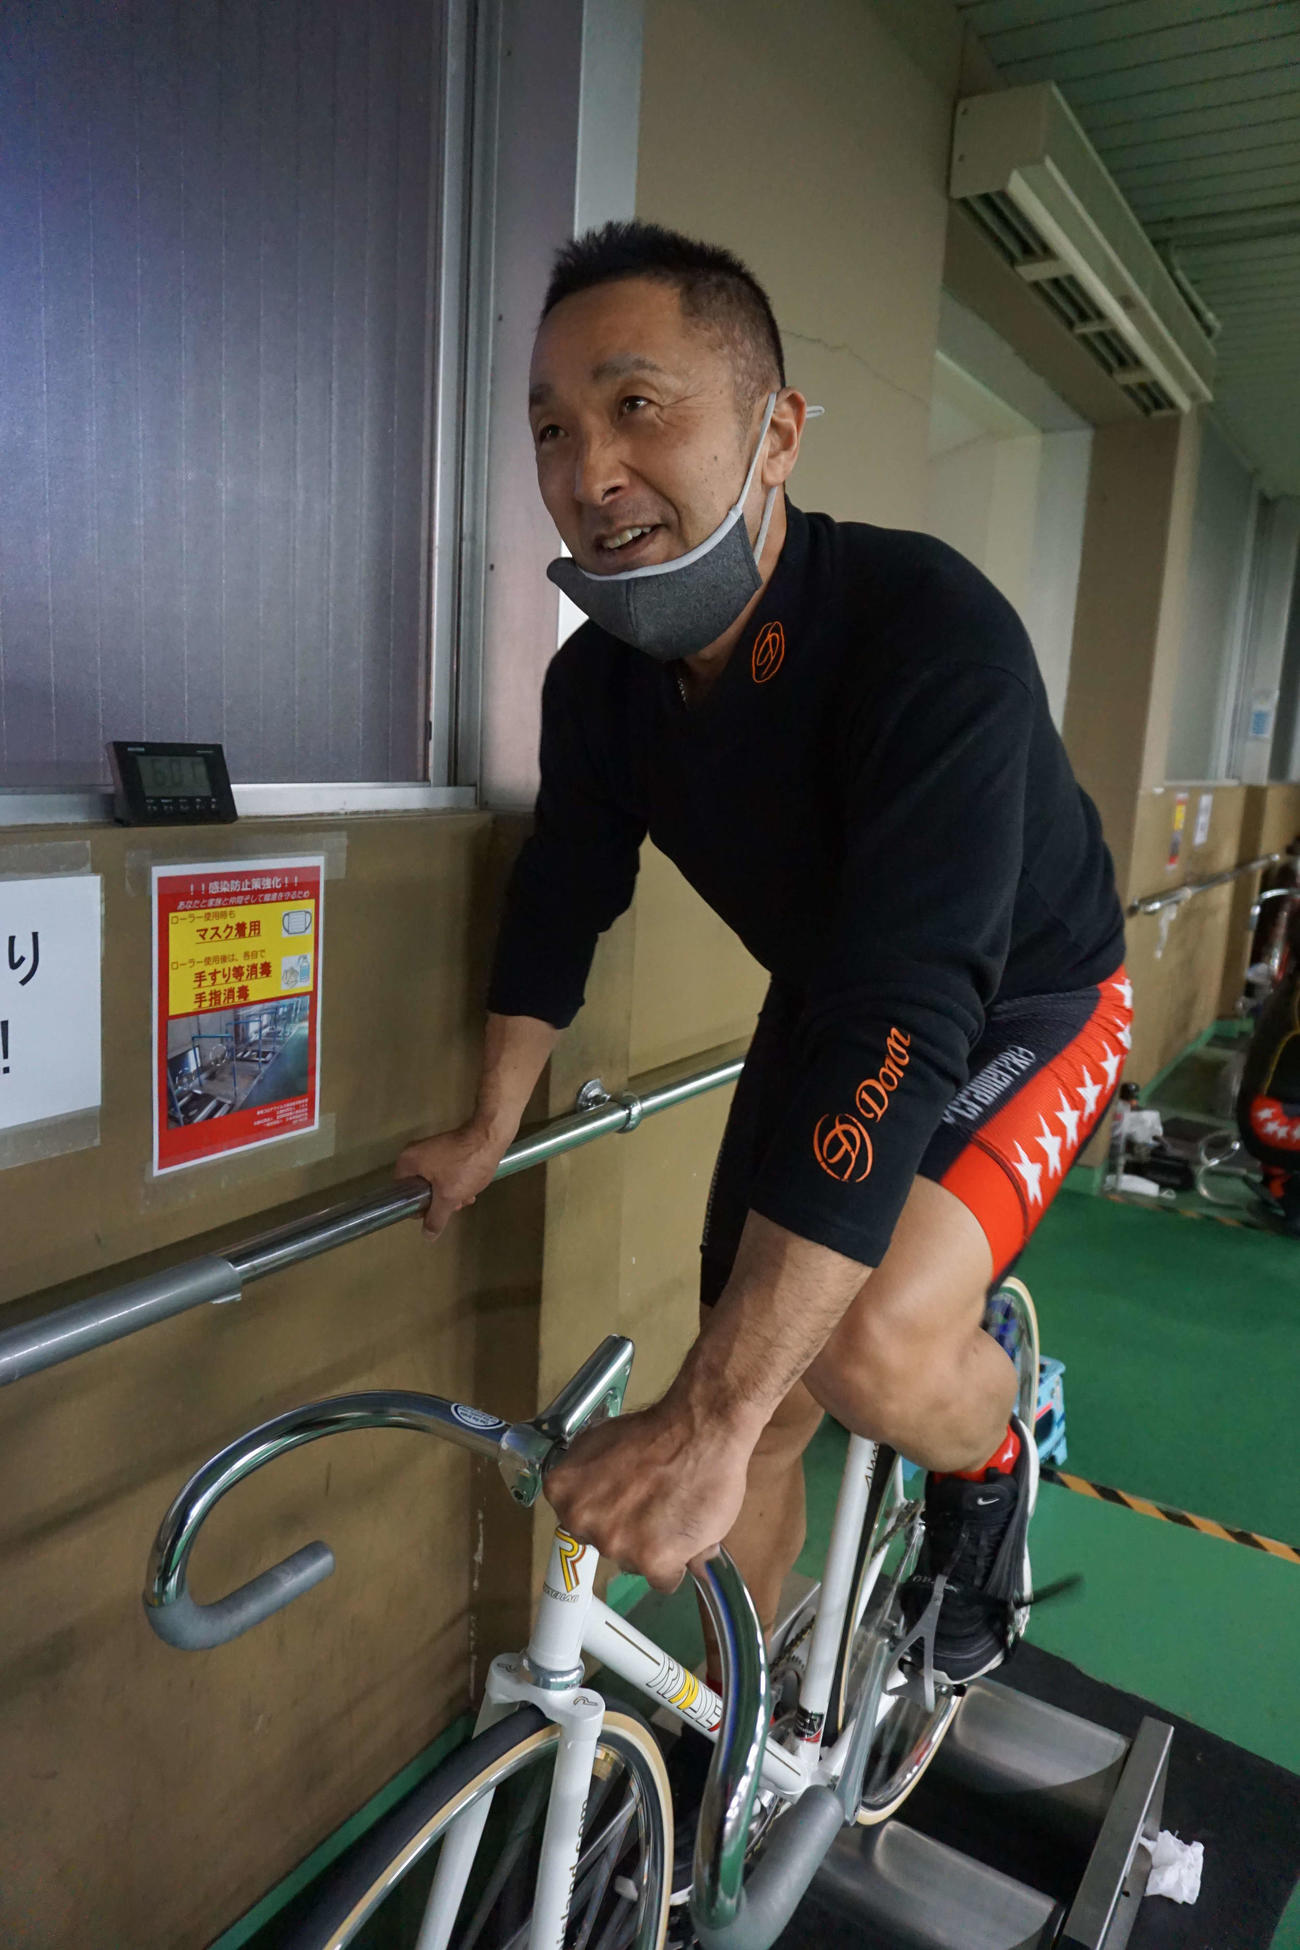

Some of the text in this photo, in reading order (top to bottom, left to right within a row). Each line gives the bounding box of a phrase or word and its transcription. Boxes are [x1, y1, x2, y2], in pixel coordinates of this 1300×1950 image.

[196, 920, 261, 941] マスク着用
[8, 931, 40, 987] り
[193, 961, 272, 988] 手すり等消毒
[194, 985, 250, 1009] 手指消毒
